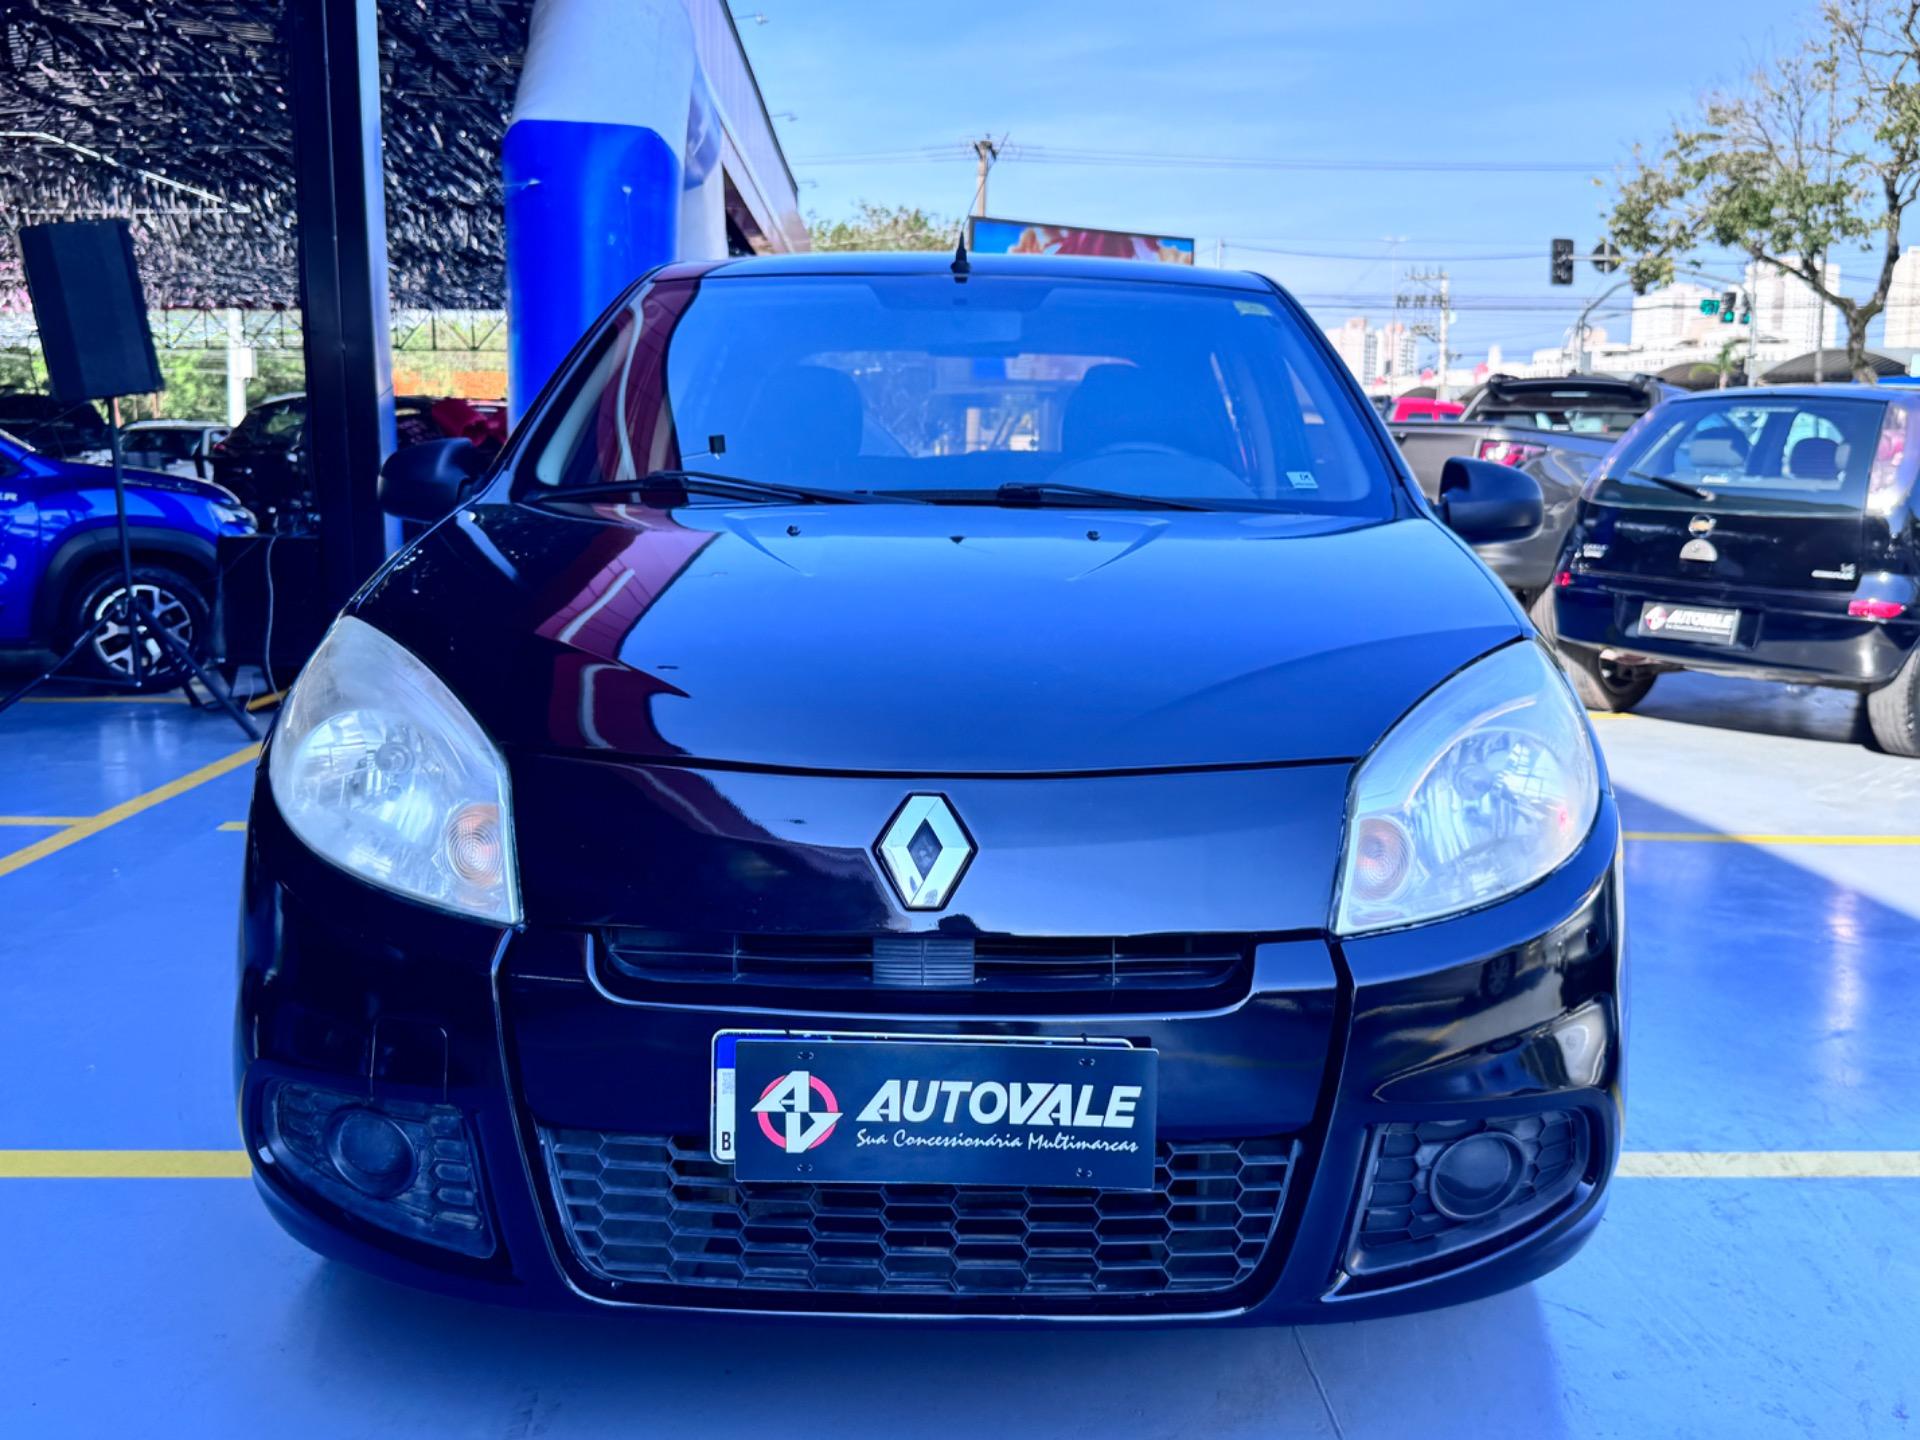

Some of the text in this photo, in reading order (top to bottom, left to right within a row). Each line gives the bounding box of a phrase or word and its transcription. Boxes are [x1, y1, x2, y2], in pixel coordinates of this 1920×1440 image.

[855, 1079, 1142, 1128] AUTOVALE
[721, 1131, 735, 1151] B
[856, 1127, 1139, 1153] Sua Concessionária Multimarcas
